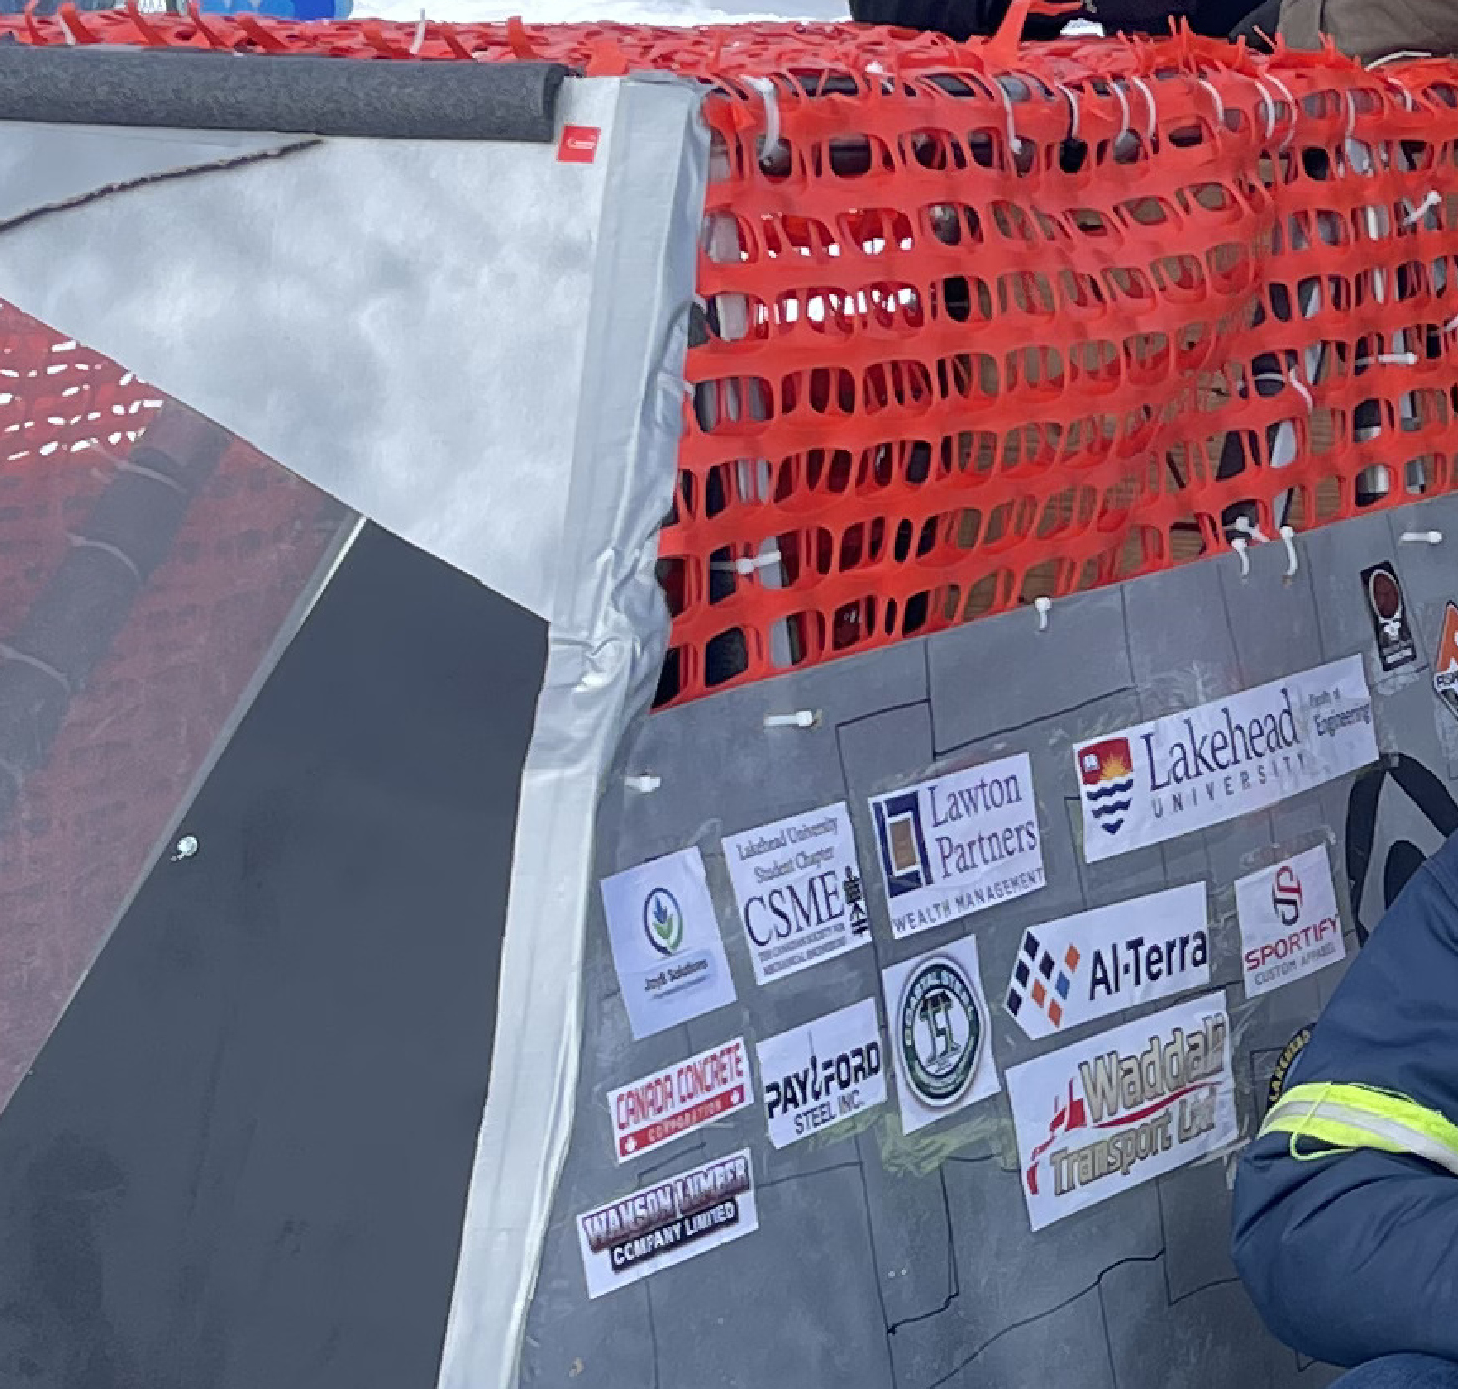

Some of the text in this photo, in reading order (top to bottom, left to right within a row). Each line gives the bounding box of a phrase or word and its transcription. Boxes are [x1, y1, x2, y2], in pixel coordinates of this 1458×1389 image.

[1140, 688, 1299, 792] Lakehead
[1313, 703, 1370, 737] Engineering
[928, 774, 1022, 827] Lawton
[1151, 754, 1305, 818] UNIVERSITY
[736, 817, 838, 860] Lakehead University
[754, 846, 835, 883] Student Chapter
[935, 820, 1037, 879] Partners
[744, 871, 844, 946] CSME
[893, 867, 1043, 932] WEALTH MANAGEMENT
[1089, 930, 1208, 1000] Al-Terra
[1245, 917, 1339, 970] SPORTIFY
[1254, 954, 1297, 986] CUSTOM
[617, 1042, 744, 1129] CANADA CONCRETE
[794, 1101, 836, 1135] STEEL
[1050, 1108, 1172, 1196] Transport
[613, 1200, 736, 1266] COMPANY LIMITED
